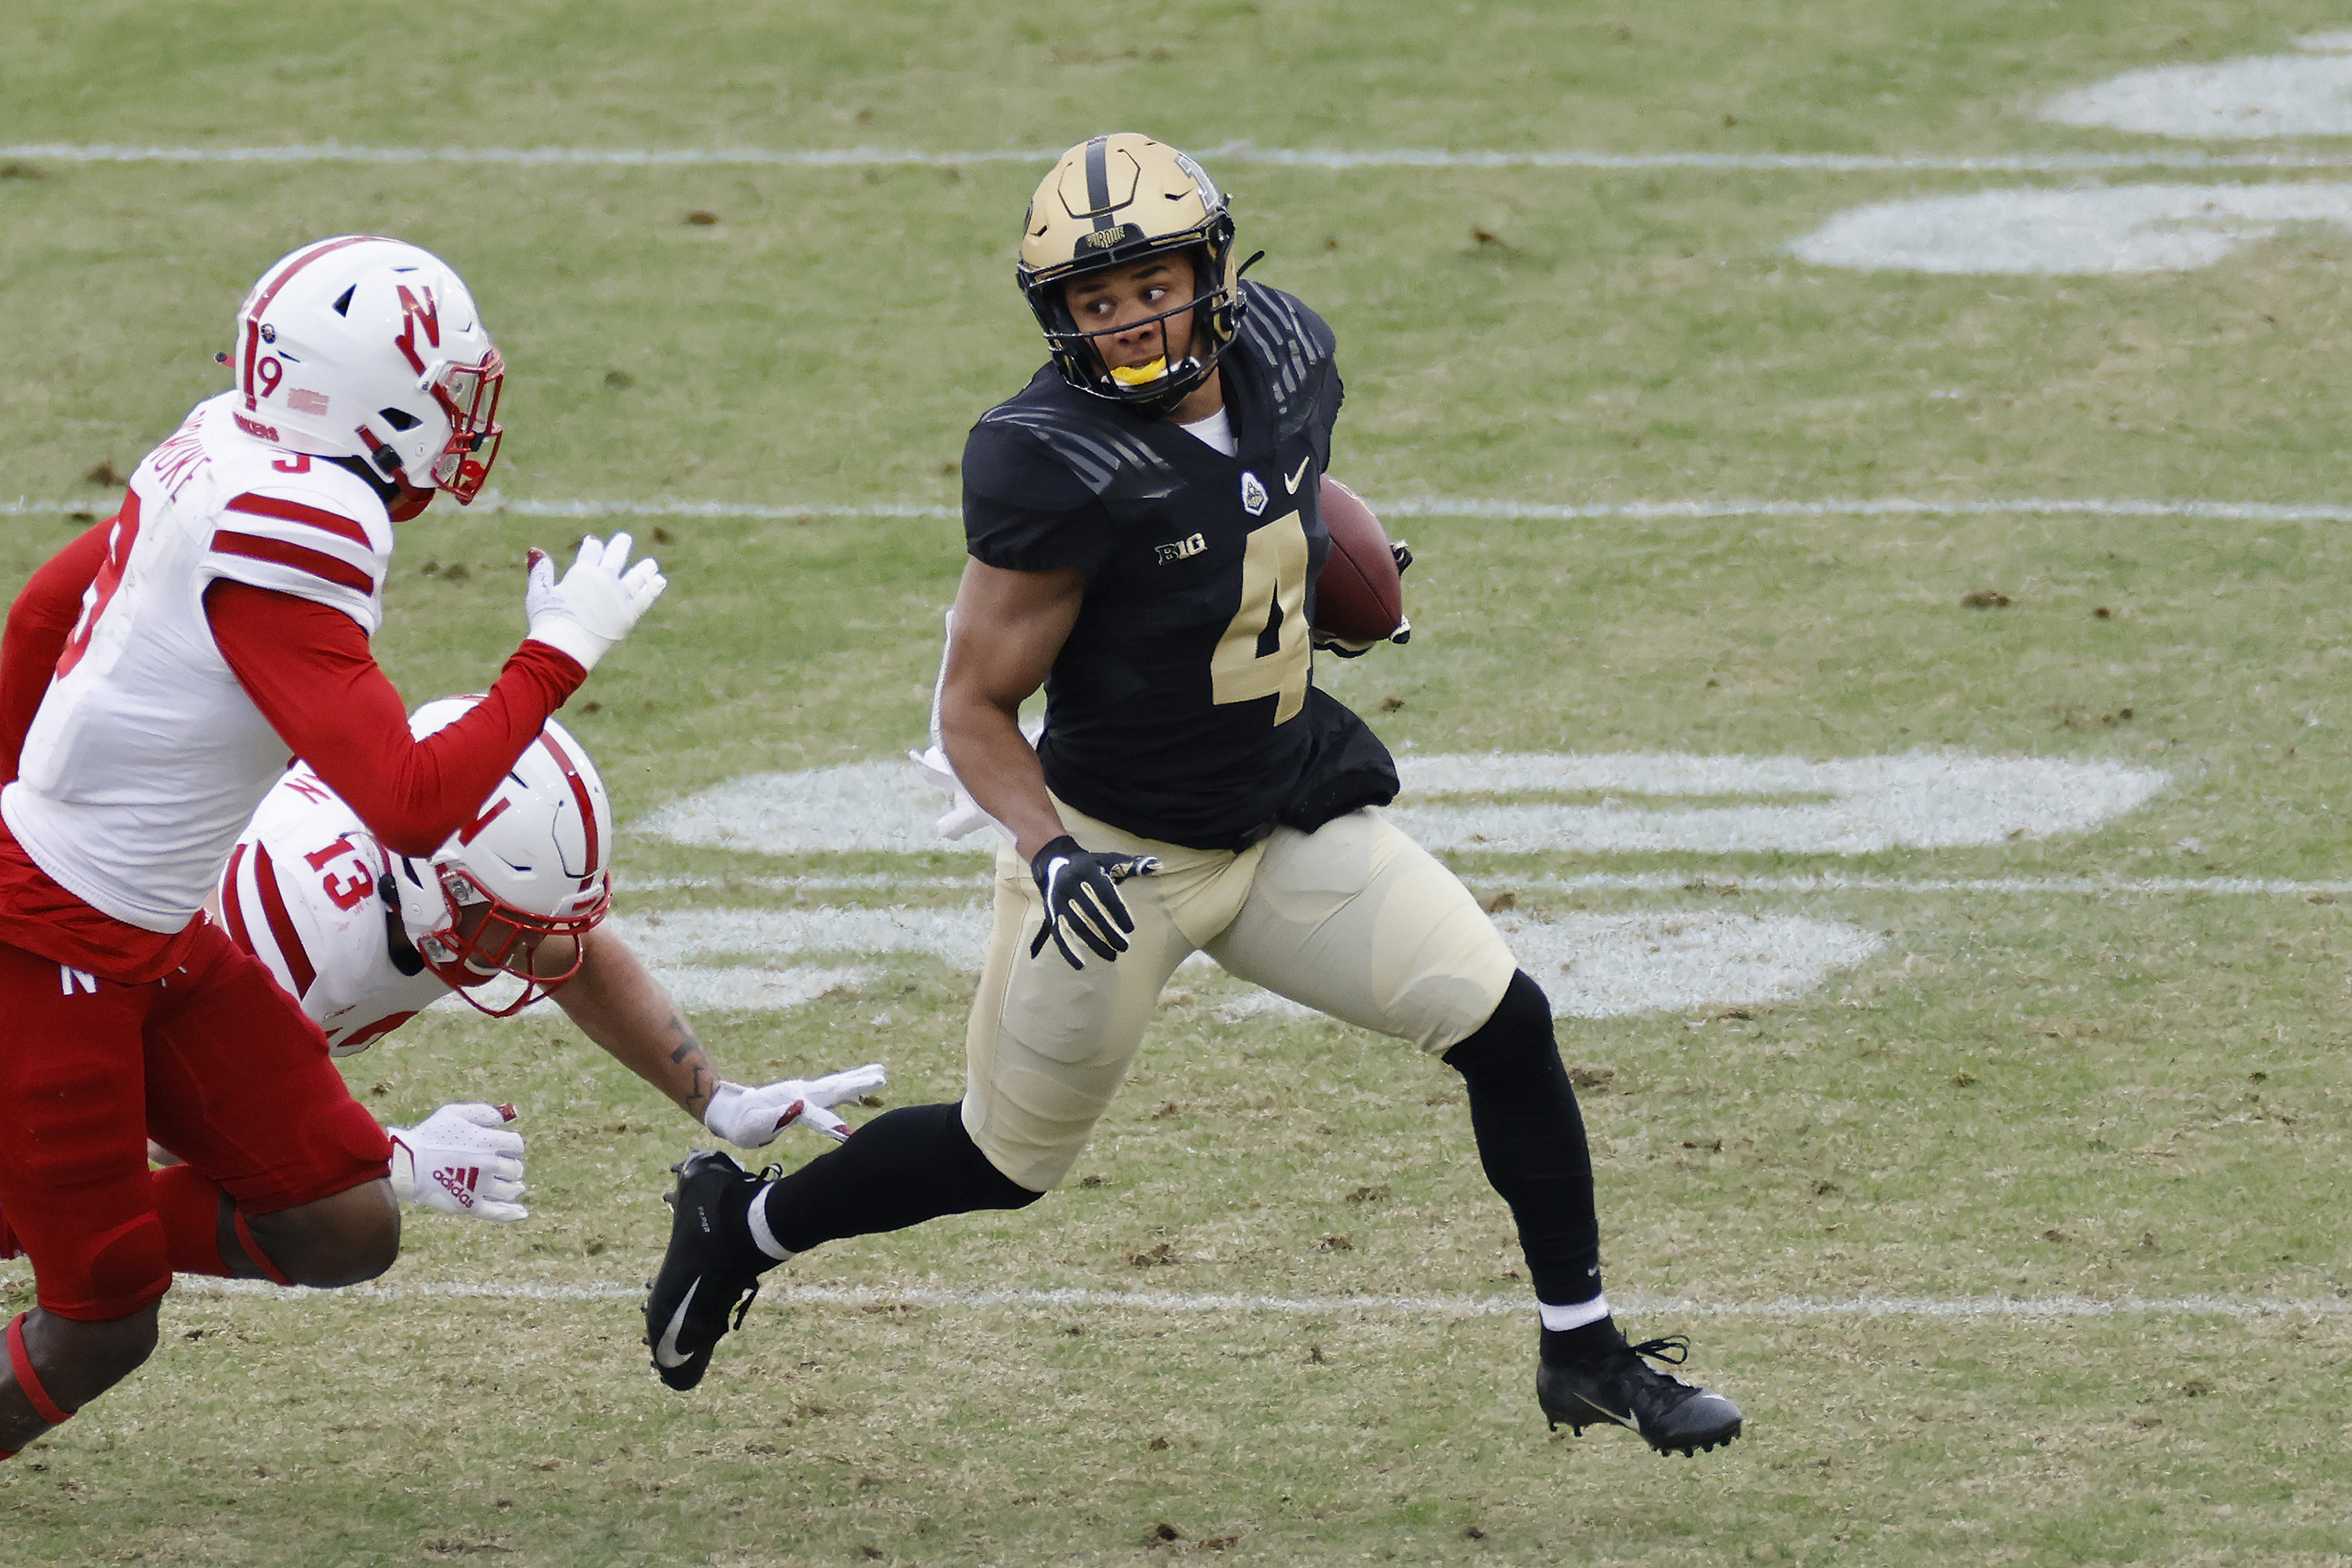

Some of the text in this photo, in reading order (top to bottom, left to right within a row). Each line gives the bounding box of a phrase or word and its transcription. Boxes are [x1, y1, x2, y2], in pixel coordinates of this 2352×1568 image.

[396, 285, 440, 349] N
[257, 357, 283, 398] 9
[1210, 509, 1311, 728] 4
[303, 838, 374, 911] 13
[433, 1170, 474, 1208] adidas
